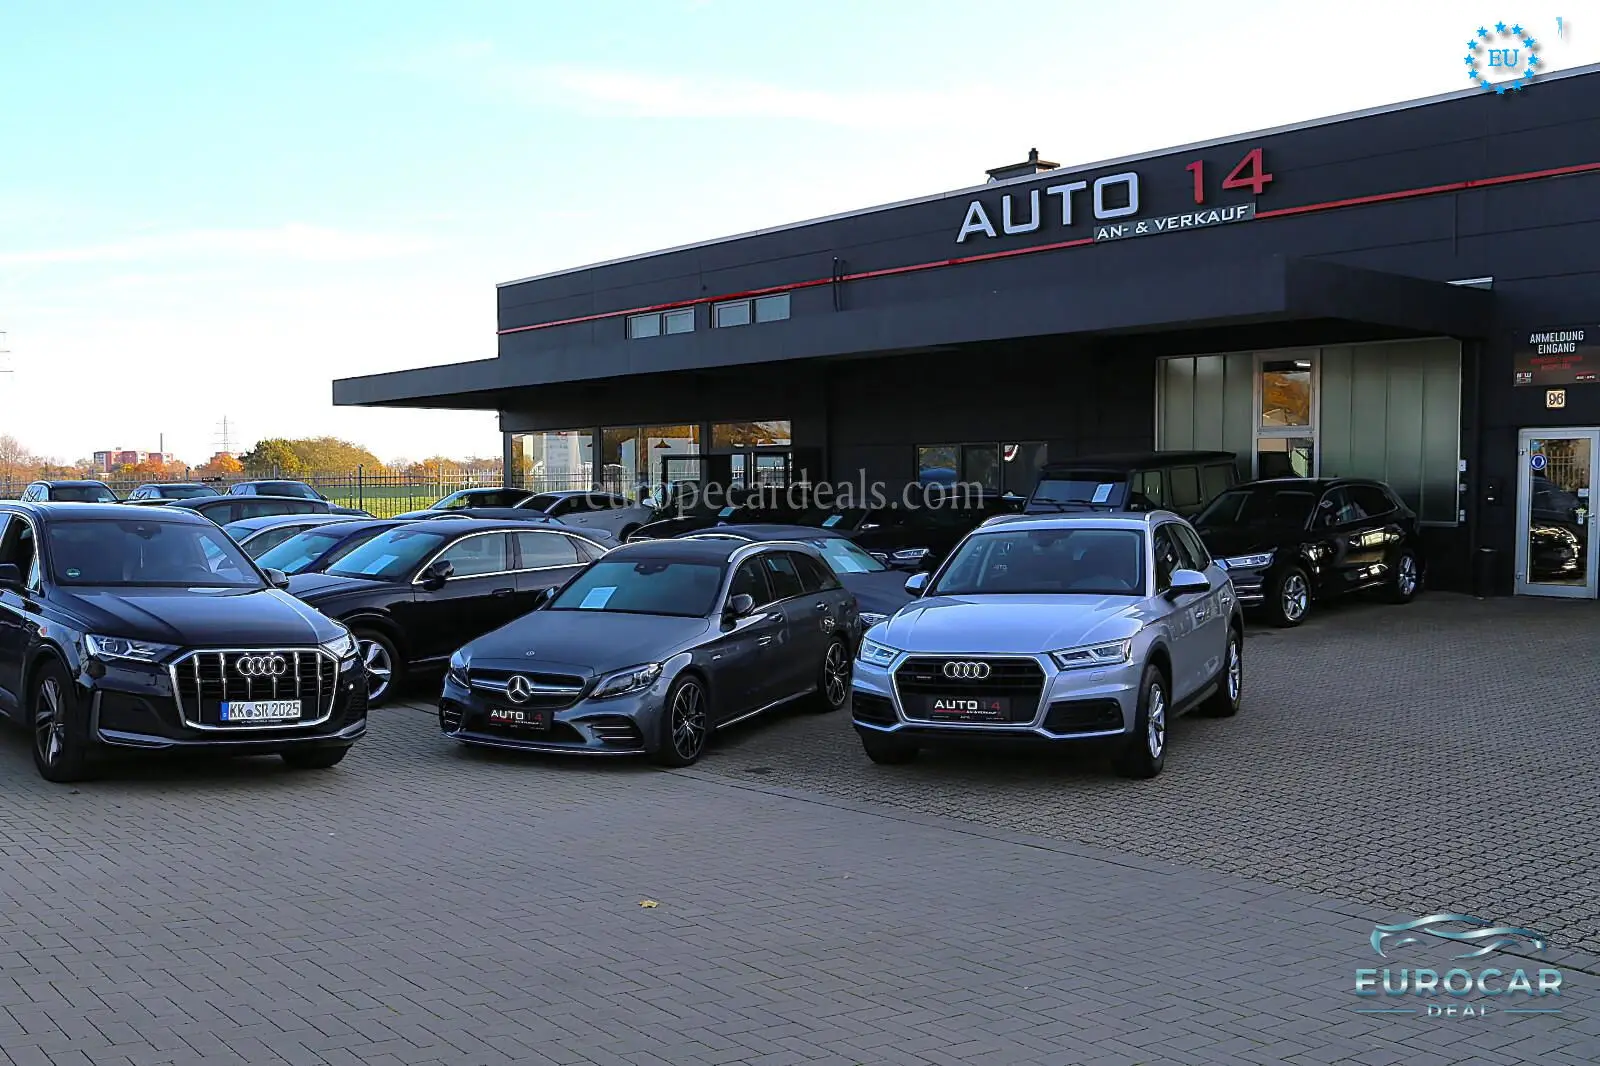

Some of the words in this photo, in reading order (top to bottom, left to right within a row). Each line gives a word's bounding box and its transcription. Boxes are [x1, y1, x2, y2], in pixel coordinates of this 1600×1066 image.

[956, 171, 1139, 243] AUTO
[1184, 148, 1273, 204] 14
[1097, 225, 1129, 240] AN-
[1135, 221, 1149, 234] &
[1154, 205, 1248, 231] VERKAUF
[1529, 330, 1585, 344] ANMELDUNG
[1538, 342, 1576, 355] EINGANG
[1548, 392, 1564, 406] 96
[229, 703, 246, 718] KK
[253, 703, 269, 717] SR
[271, 701, 300, 717] 2025
[934, 699, 978, 710] AUTO
[490, 709, 524, 720] AUTO
